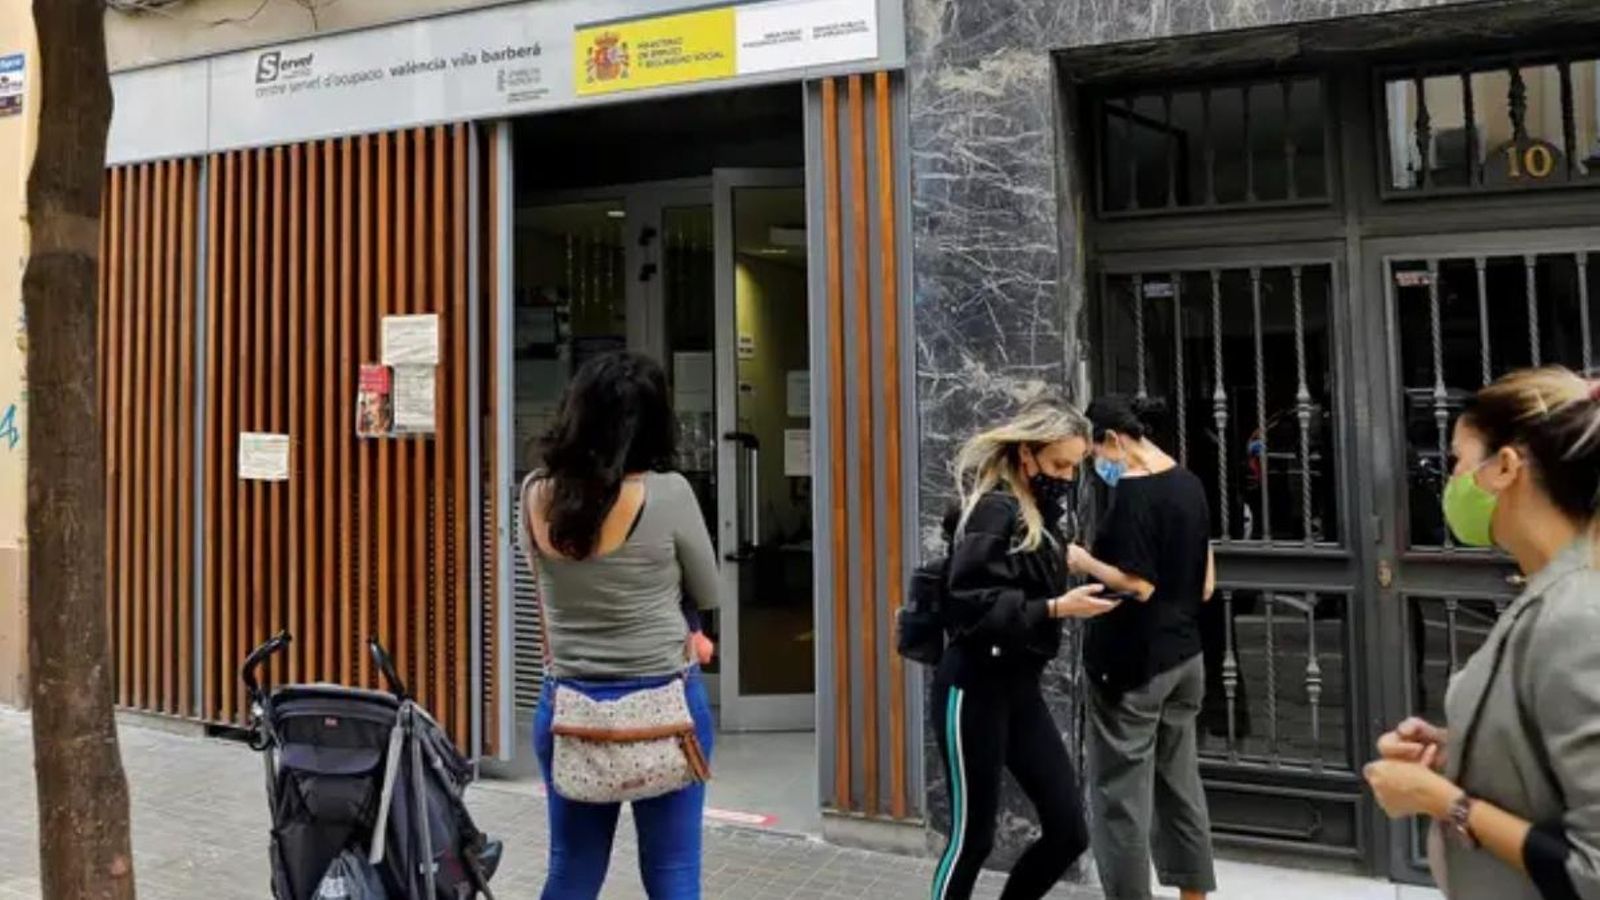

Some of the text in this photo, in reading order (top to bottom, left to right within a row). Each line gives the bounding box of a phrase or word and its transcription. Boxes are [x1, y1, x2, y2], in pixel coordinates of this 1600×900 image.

[450, 52, 477, 68] vila
[694, 51, 724, 61] SOCIAL
[1506, 145, 1552, 177] 10
